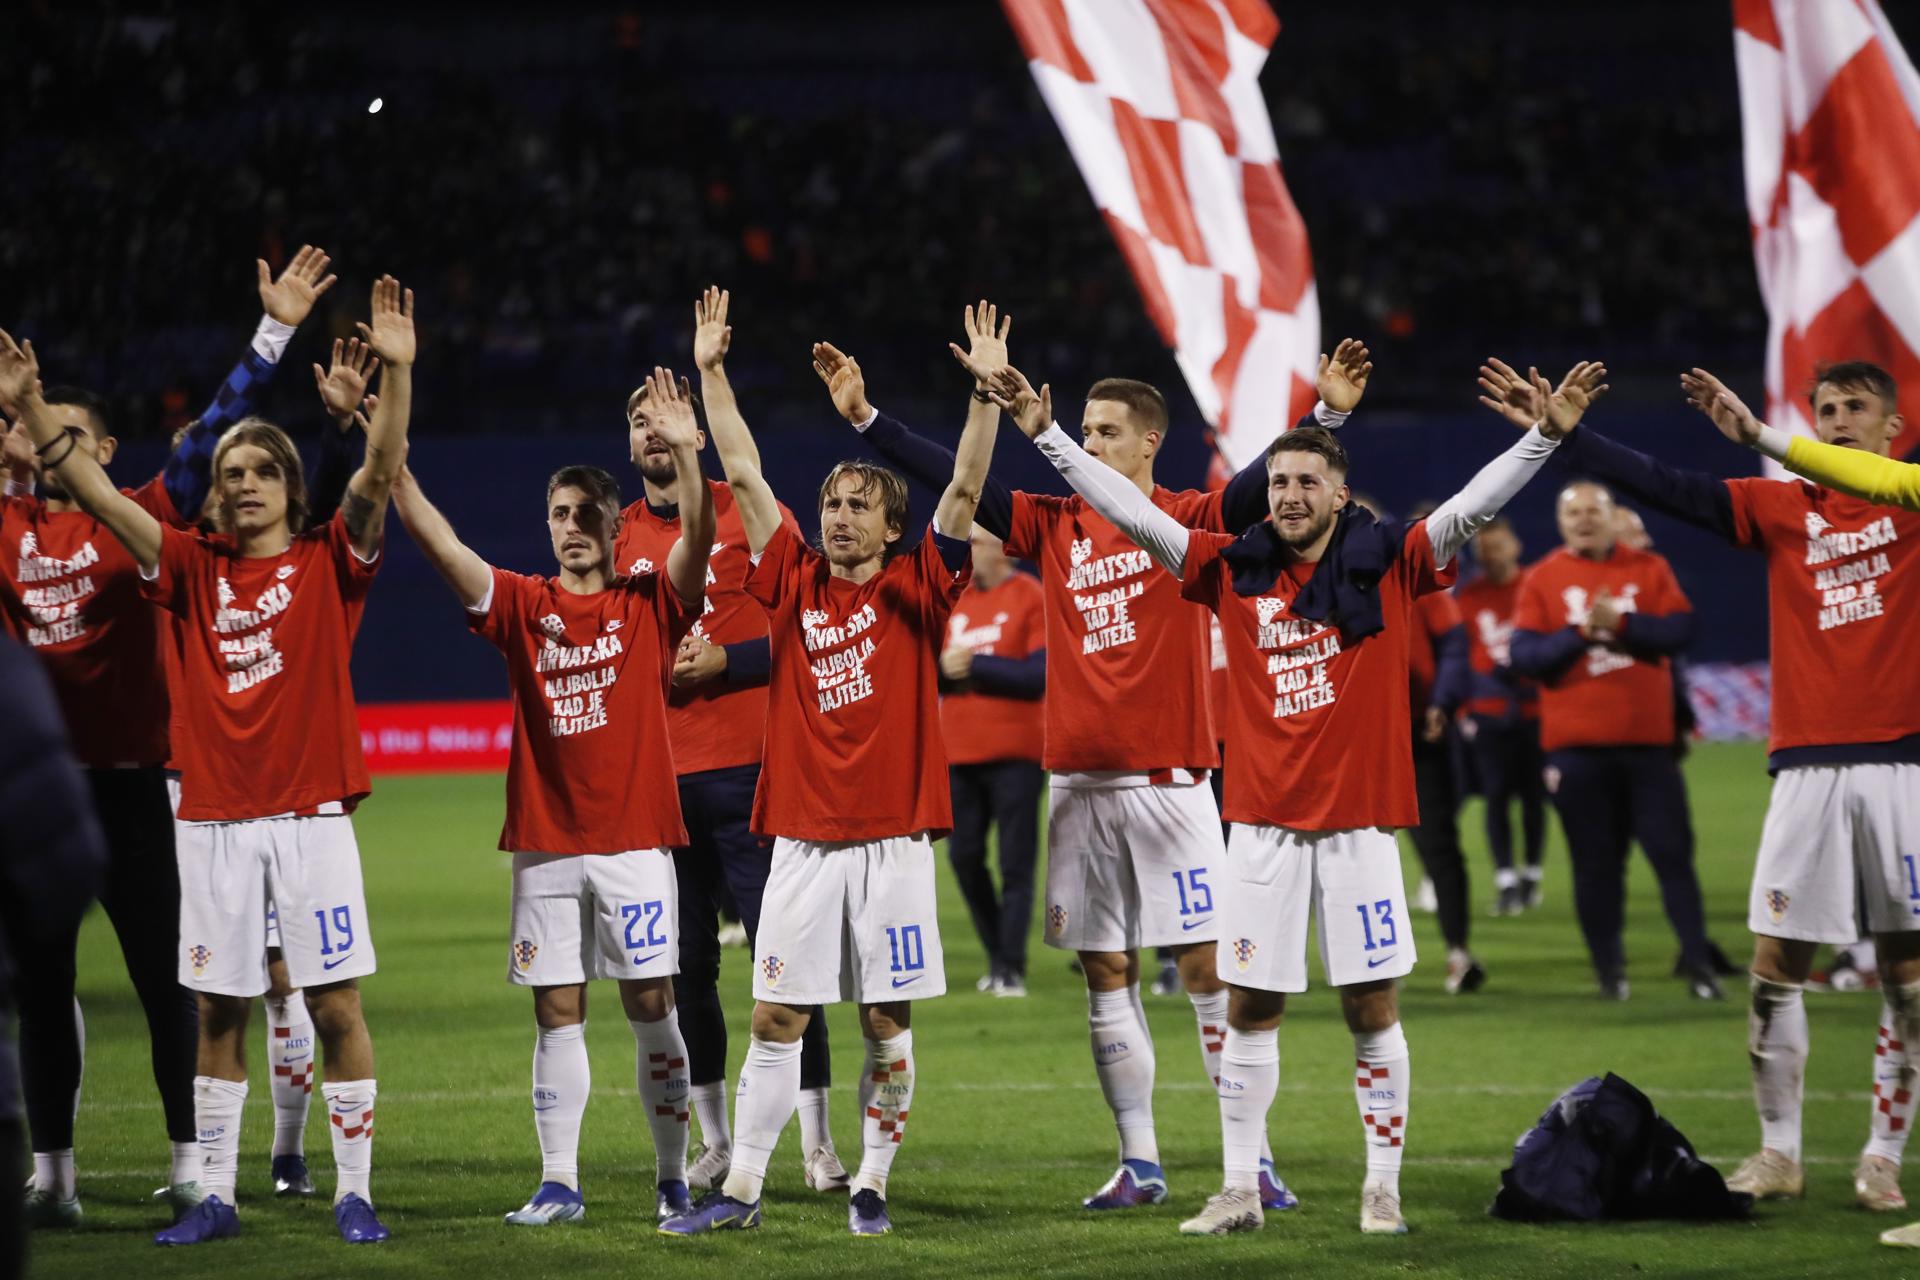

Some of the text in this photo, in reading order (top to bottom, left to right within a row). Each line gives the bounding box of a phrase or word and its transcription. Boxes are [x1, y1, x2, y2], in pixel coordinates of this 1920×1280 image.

[1065, 549, 1153, 591] HRVATSKA
[1083, 600, 1129, 632] KAD JE
[536, 634, 623, 672] HRVATSKA
[811, 636, 876, 677] NAJBOLJA
[1267, 635, 1341, 675] NAJBOLJA
[545, 665, 617, 699] NAJBOLJA
[1276, 662, 1328, 695] KAD JE
[553, 690, 604, 717] KAD JE
[1172, 867, 1214, 916] 15
[315, 905, 354, 955] 19
[621, 900, 668, 949] 22
[1356, 899, 1397, 951] 13
[886, 924, 925, 972] 10
